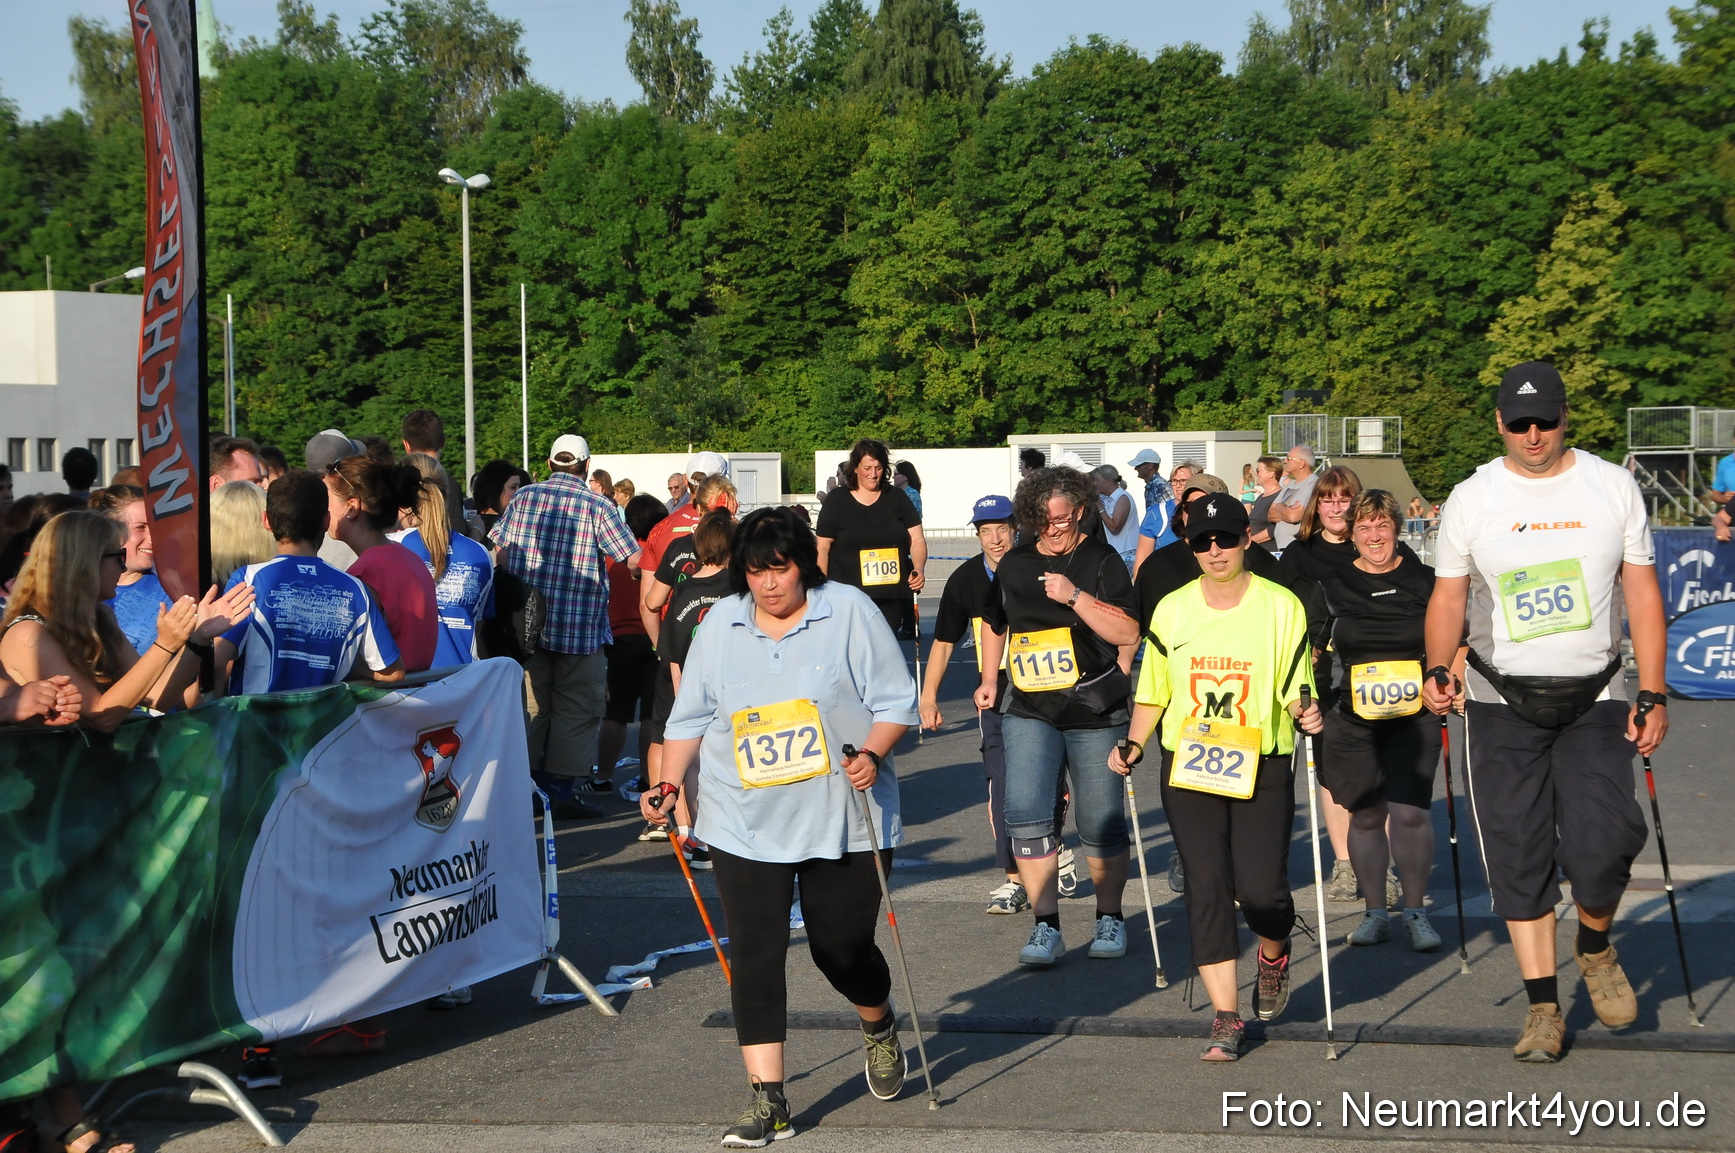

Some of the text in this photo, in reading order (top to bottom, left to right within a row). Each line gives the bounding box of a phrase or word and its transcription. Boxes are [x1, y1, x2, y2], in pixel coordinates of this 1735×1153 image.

[1531, 521, 1587, 531] KLEBL
[670, 552, 690, 569] Neumarkter
[863, 561, 898, 576] 1108
[676, 599, 701, 623] Neumarkter
[1516, 584, 1574, 621] 556
[1013, 649, 1074, 677] 1115
[1191, 657, 1252, 671] Müller
[1203, 691, 1235, 719] M
[1355, 682, 1419, 705] 1099
[738, 726, 822, 769] 1372
[760, 761, 807, 774] Hannelore Hofmann
[1184, 743, 1245, 779] 282
[1196, 773, 1213, 781] Sabrina
[425, 802, 453, 823] 1628
[389, 840, 490, 902] Neumarkter
[369, 876, 499, 964] Lammsbräu
